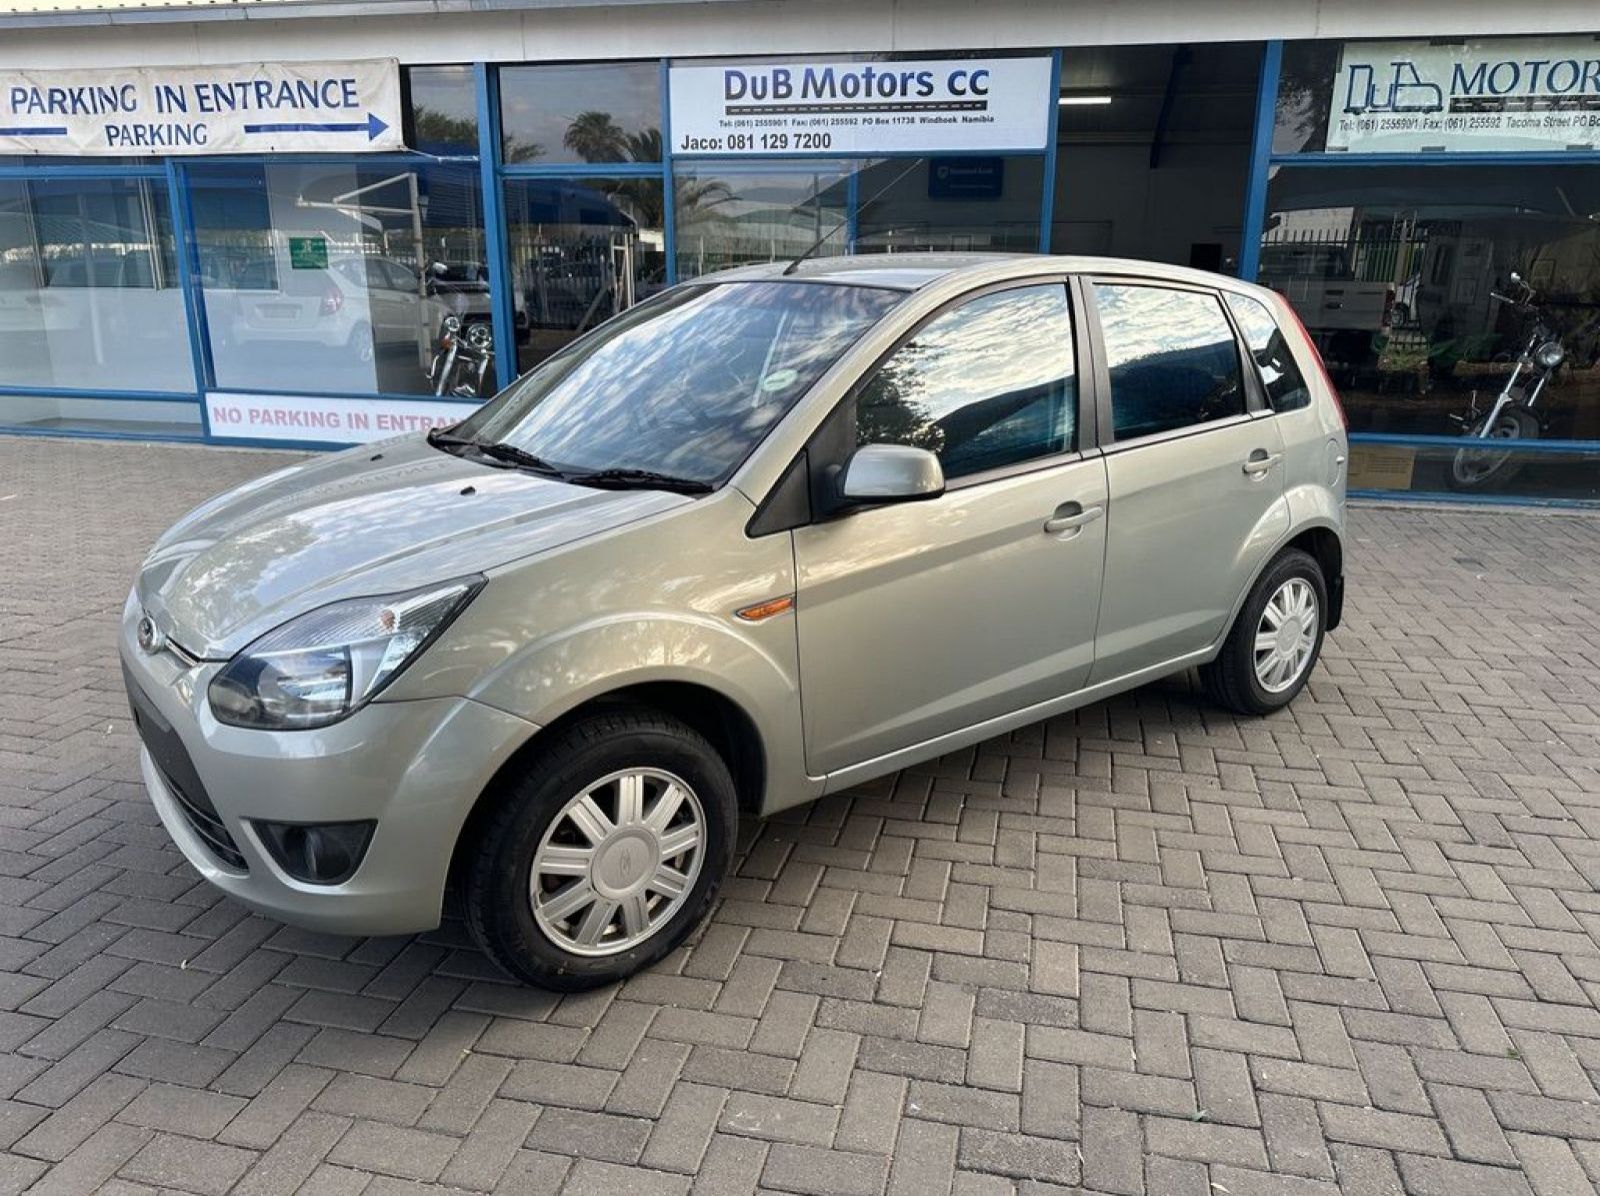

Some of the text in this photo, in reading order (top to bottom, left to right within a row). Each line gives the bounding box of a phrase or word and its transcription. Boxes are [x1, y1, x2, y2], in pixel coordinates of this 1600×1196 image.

[724, 69, 793, 100] DuB
[802, 66, 934, 99] Motors
[1449, 59, 1600, 95] MOTOR
[11, 78, 360, 115] PARKING IN ENTRANCE
[734, 119, 753, 128] (061)
[809, 118, 829, 127] (061)
[862, 117, 873, 125] PO
[875, 117, 890, 125] Box
[962, 114, 995, 124] Namibia
[1356, 119, 1379, 133] (061)
[1422, 117, 1443, 130] Fax:
[1445, 117, 1467, 132] (061)
[1506, 116, 1541, 129] Tacoma
[1543, 115, 1571, 128] Street
[1573, 114, 1587, 127] PO
[105, 123, 208, 147] PARKING
[680, 132, 831, 150] Jaco: 081 129 7200
[213, 406, 242, 424] NO
[248, 407, 340, 428] PARKING
[347, 412, 369, 430] IN
